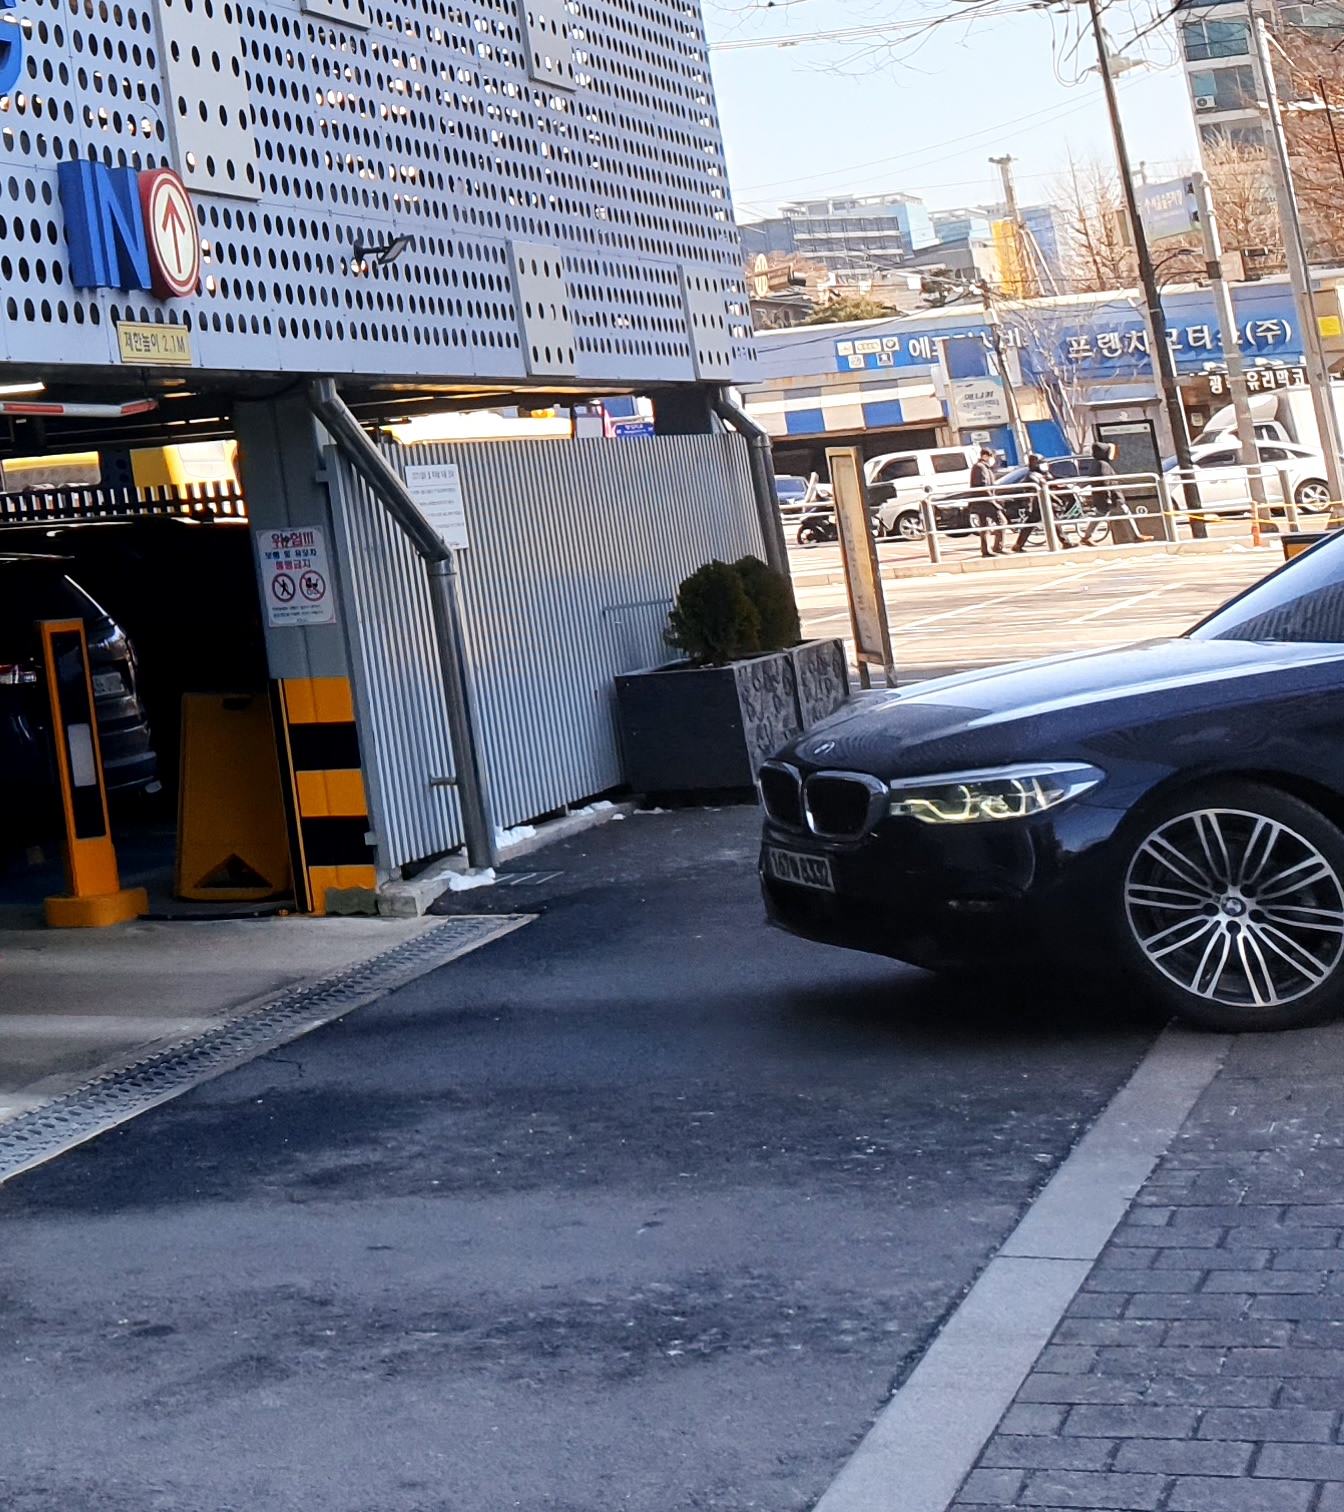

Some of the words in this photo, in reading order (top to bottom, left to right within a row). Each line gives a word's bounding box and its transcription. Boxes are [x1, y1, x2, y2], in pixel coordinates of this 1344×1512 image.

[57, 158, 154, 290] IN
[123, 331, 160, 354] 제한높이
[162, 334, 186, 354] 2.1M
